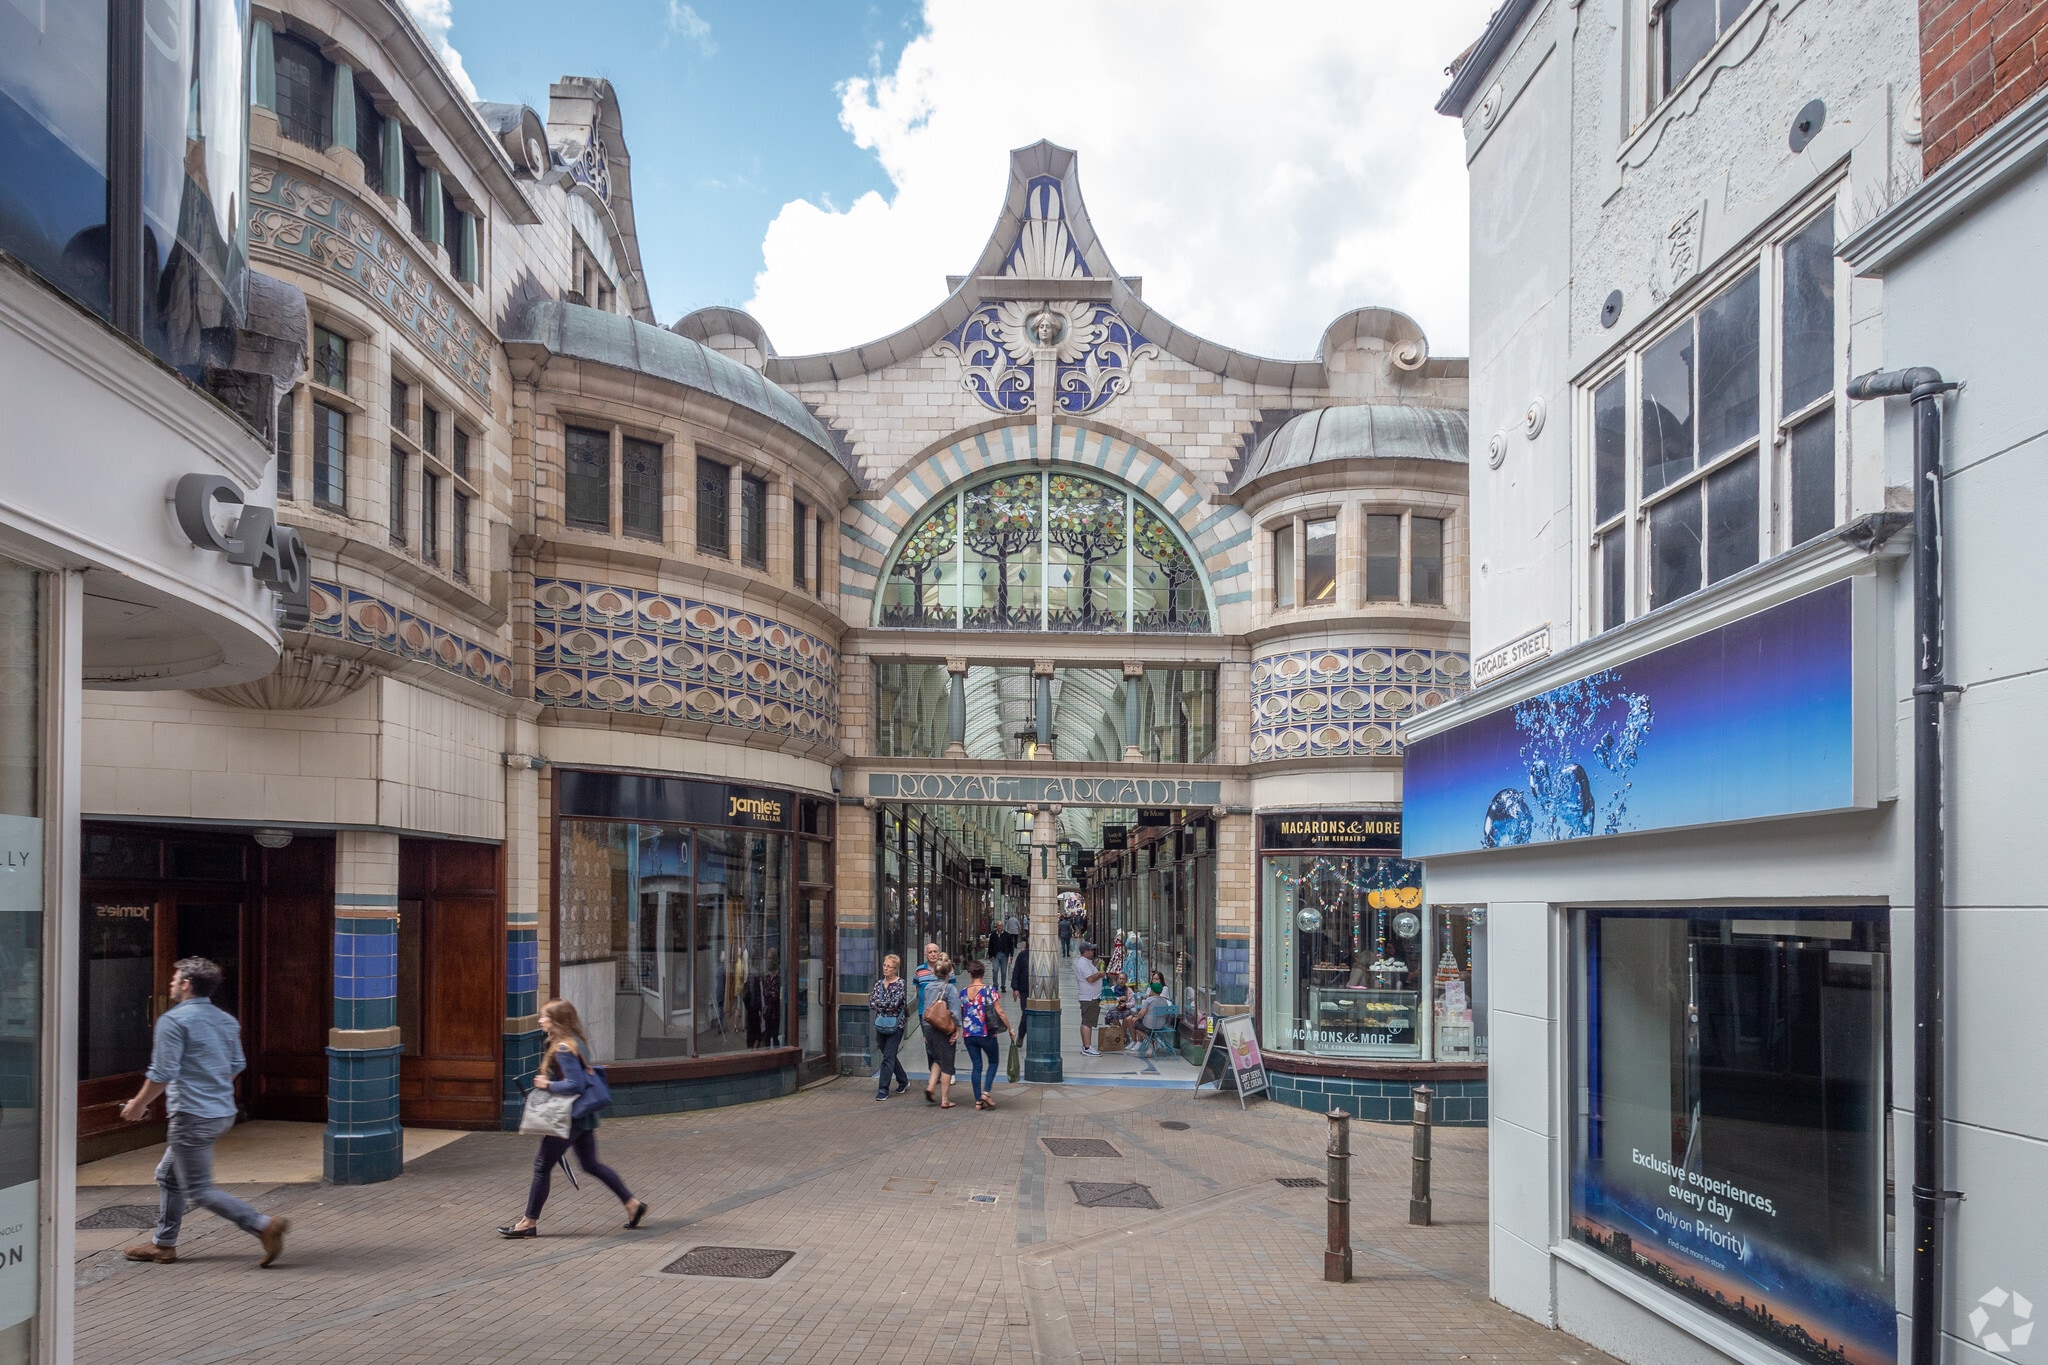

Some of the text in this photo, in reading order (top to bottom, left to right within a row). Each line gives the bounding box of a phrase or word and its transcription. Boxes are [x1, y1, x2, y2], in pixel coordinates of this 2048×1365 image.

[1476, 633, 1546, 678] ARCADE STREET
[898, 774, 1192, 804] ROYAL ARCADE
[728, 796, 781, 816] Jamie's
[753, 814, 780, 822] ITALIAN
[1281, 821, 1400, 834] MACARONS & MORE
[1285, 1028, 1393, 1045] MACARONS & MORE
[1240, 1072, 1251, 1083] SOFT
[1632, 1148, 1777, 1217] Exclusive experiences,
[1669, 1184, 1734, 1223] every day
[1656, 1206, 1746, 1261] Only on Priority
[1667, 1238, 1726, 1271] Find out more in store
